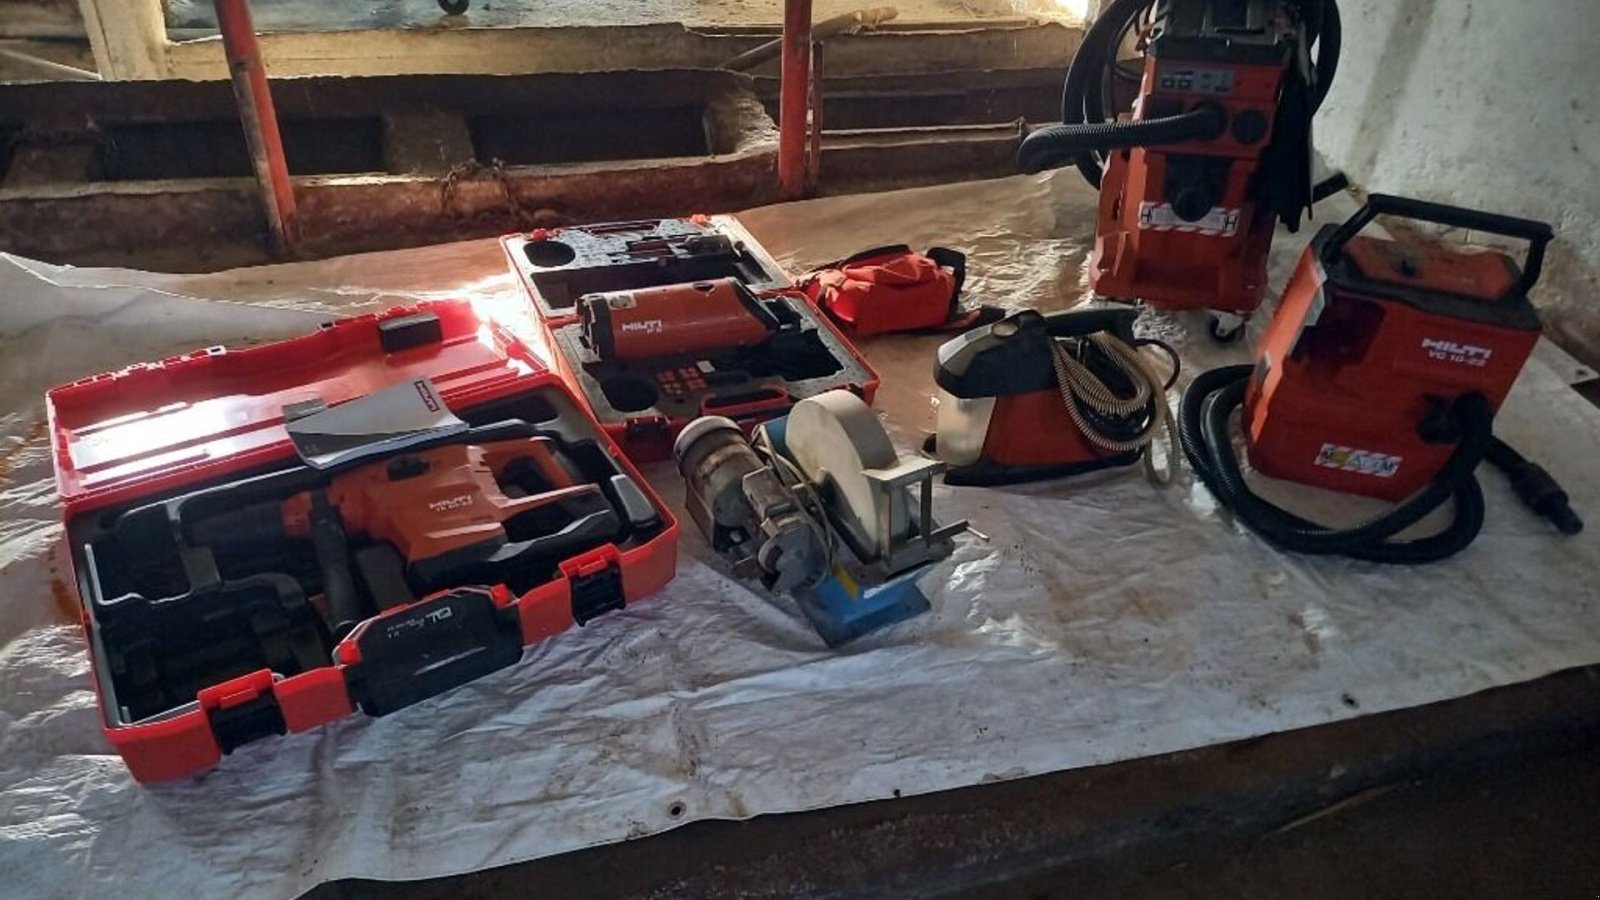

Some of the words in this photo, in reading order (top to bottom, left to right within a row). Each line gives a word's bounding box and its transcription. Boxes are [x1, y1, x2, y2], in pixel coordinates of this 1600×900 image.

[1224, 214, 1237, 231] H
[622, 319, 662, 331] HILTI
[1421, 338, 1492, 359] HILTI
[415, 381, 438, 411] HILTI
[429, 495, 471, 509] HILTI
